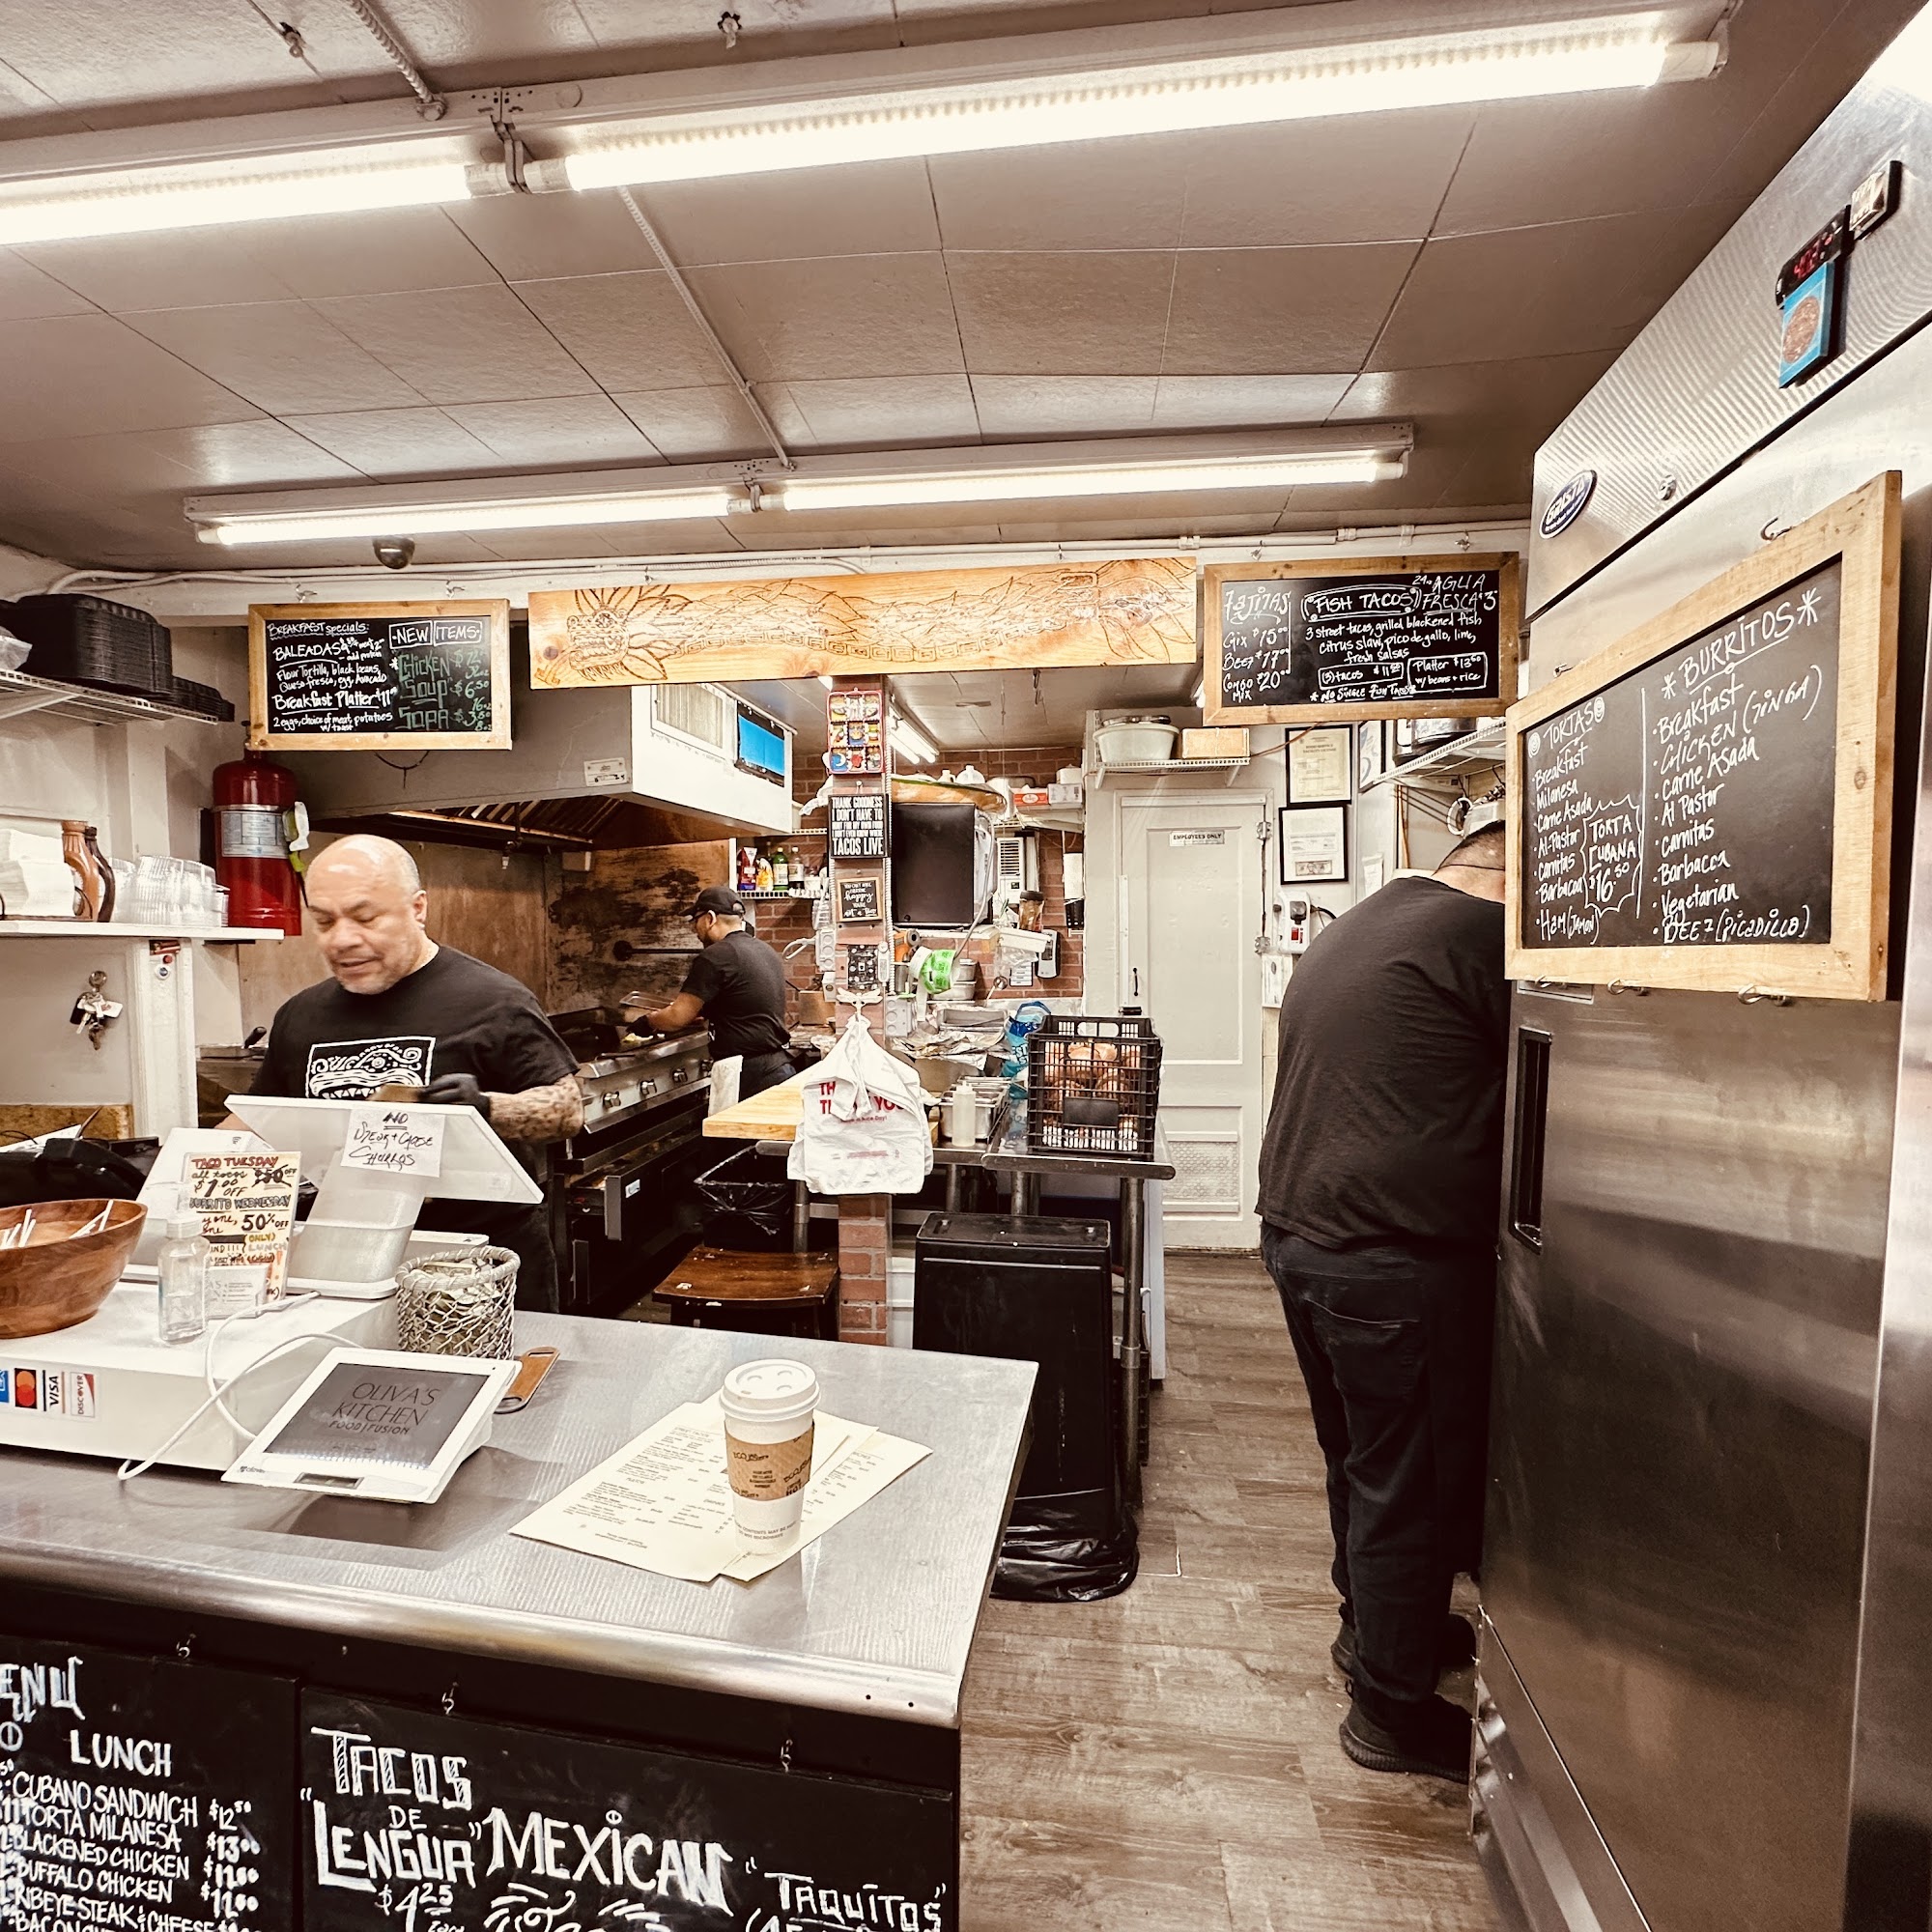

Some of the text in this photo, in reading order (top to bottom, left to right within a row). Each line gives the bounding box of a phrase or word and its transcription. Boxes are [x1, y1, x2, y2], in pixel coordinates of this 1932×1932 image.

[1316, 590, 1415, 613] FISH TACOS
[267, 622, 326, 639] BREAKFAST
[397, 626, 430, 645] NEW
[436, 625, 477, 641] ITEMS
[1304, 627, 1315, 640] 3
[1315, 624, 1346, 638] street
[1375, 617, 1406, 638] grilled
[1406, 614, 1455, 630] blackened
[1456, 611, 1483, 626] fish
[272, 641, 341, 662] BALEADAS
[1319, 640, 1353, 655] Citrus
[1383, 634, 1410, 653] pico
[1410, 630, 1424, 643] de
[1422, 630, 1452, 648] gallo,
[1343, 646, 1410, 665] fresh salsas
[1679, 599, 1796, 687] BURRiTOS
[276, 668, 300, 682] Flour
[331, 664, 355, 676] black
[1335, 669, 1364, 681] tacos
[1411, 661, 1450, 673] Platter
[1427, 673, 1452, 686] beans
[1459, 672, 1482, 683] rice
[279, 679, 305, 693] Queso
[271, 691, 375, 710] Breakfast Platter
[1658, 673, 1745, 747] Breakfast
[273, 717, 281, 727] 2
[301, 714, 325, 725] choice
[324, 713, 332, 724] of
[354, 712, 393, 726] potatoes
[394, 706, 450, 731] SOPA
[1543, 701, 1596, 750] TORTAS
[1535, 742, 1589, 792] Breakfast
[1662, 736, 1760, 802] Carne Asada
[1537, 779, 1579, 811] Milanesa
[1661, 781, 1725, 828] Al Pastor
[873, 808, 883, 820] TO
[1537, 792, 1594, 834] Carne Asada
[1589, 813, 1634, 843] TORTA
[832, 837, 884, 856] TACOS LIVE
[1589, 838, 1637, 873] CUBANA
[1662, 879, 1740, 932] Vegetarian
[383, 1112, 409, 1124] NO
[191, 1156, 279, 1169] TACO TUESDAY
[191, 1170, 210, 1179] all
[223, 1186, 248, 1197] OFF
[234, 1194, 292, 1209] WEDNESDAY
[241, 1213, 275, 1232] 50%
[274, 1220, 290, 1229] OFF
[47, 1375, 60, 1406] VISA
[76, 1374, 86, 1414] DISCOVER
[351, 1381, 441, 1407] OLIVA'S
[330, 1401, 429, 1428] KITCHEN
[0, 1656, 85, 1722] ENU
[70, 1728, 172, 1777] LUNCH
[310, 1725, 472, 1812] TACOS
[12, 1770, 93, 1810] CUBANO
[93, 1784, 199, 1829] SANDWICH
[25, 1798, 87, 1838] TORTA
[89, 1811, 183, 1855] MILANESA
[387, 1804, 428, 1831] DE
[14, 1828, 109, 1867] BLACKENED
[108, 1846, 190, 1882] CHICKEN
[481, 1806, 735, 1918] MEXiCAN
[17, 1859, 95, 1893] BUFFALO
[97, 1870, 174, 1904] CHICKEN
[76, 1896, 139, 1930] STEAK
